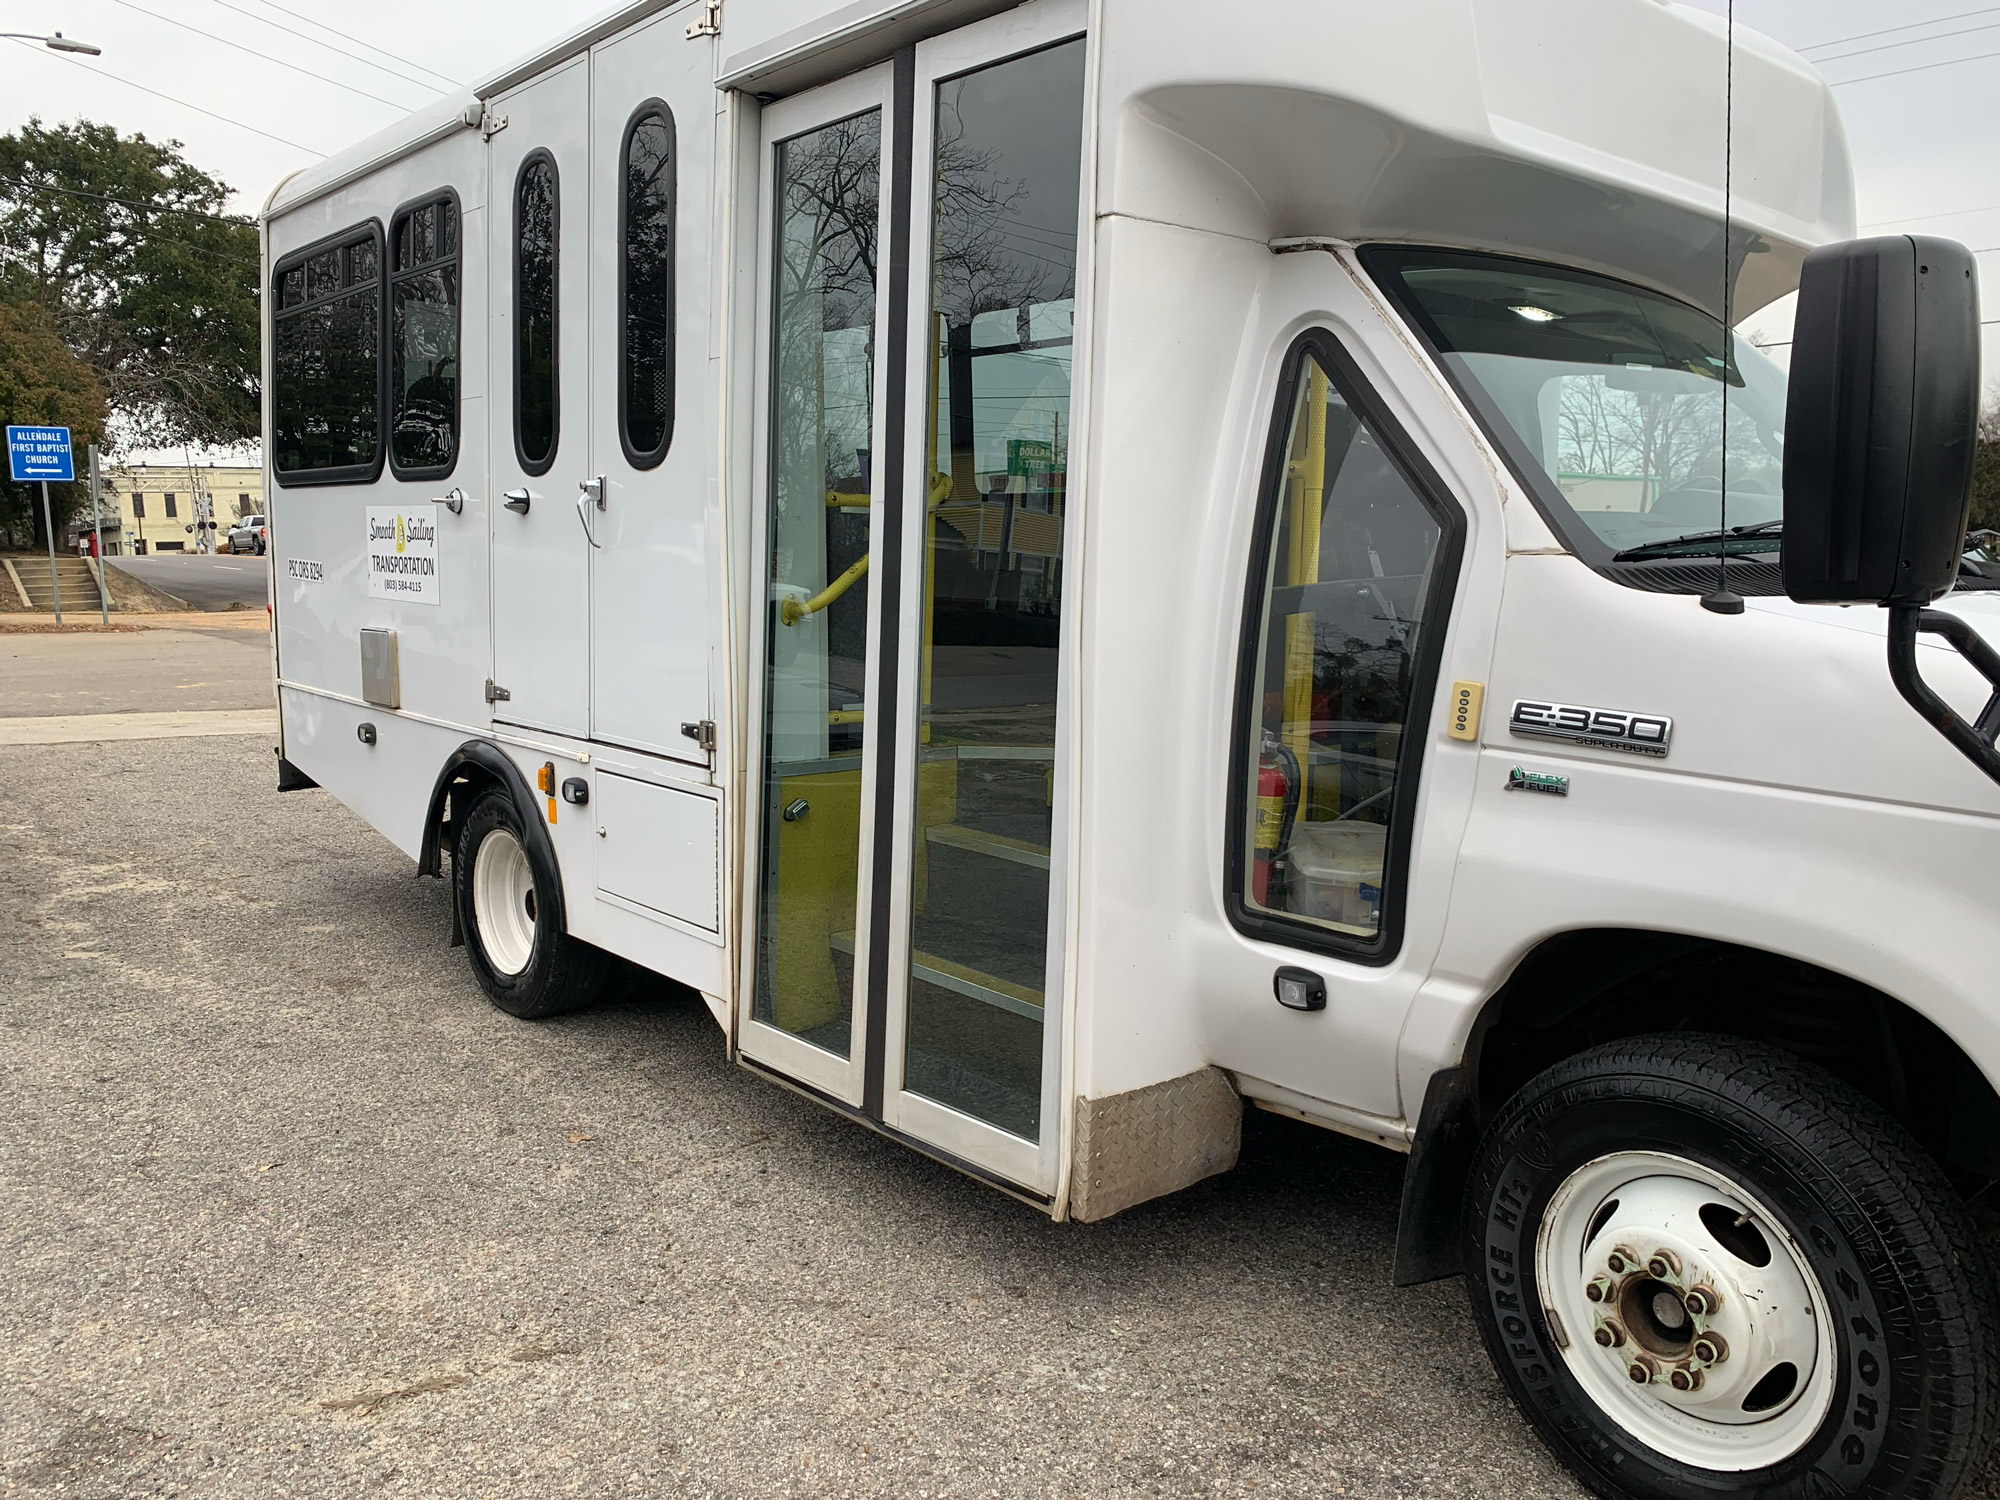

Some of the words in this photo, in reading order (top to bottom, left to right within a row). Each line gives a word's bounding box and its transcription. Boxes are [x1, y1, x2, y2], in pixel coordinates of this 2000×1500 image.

[17, 432, 61, 441] ALLENDALE
[12, 443, 34, 452] FIRST
[37, 444, 69, 453] BAPTIST
[1019, 447, 1051, 457] DOLLAR
[25, 455, 58, 464] CHURCH
[1024, 460, 1045, 469] TREE
[370, 517, 396, 541] Smooth
[406, 517, 434, 548] Sailing
[289, 560, 298, 577] PSC
[299, 561, 309, 579] ORS
[310, 562, 322, 581] 8294
[372, 555, 434, 576] TRANSPORTATION
[384, 579, 397, 592] (803)
[398, 580, 422, 592] 584-4115
[1575, 736, 1621, 750] SUPER
[1622, 743, 1661, 756] DUTY
[1529, 773, 1565, 786] FLEX
[1528, 782, 1566, 795] FUEL
